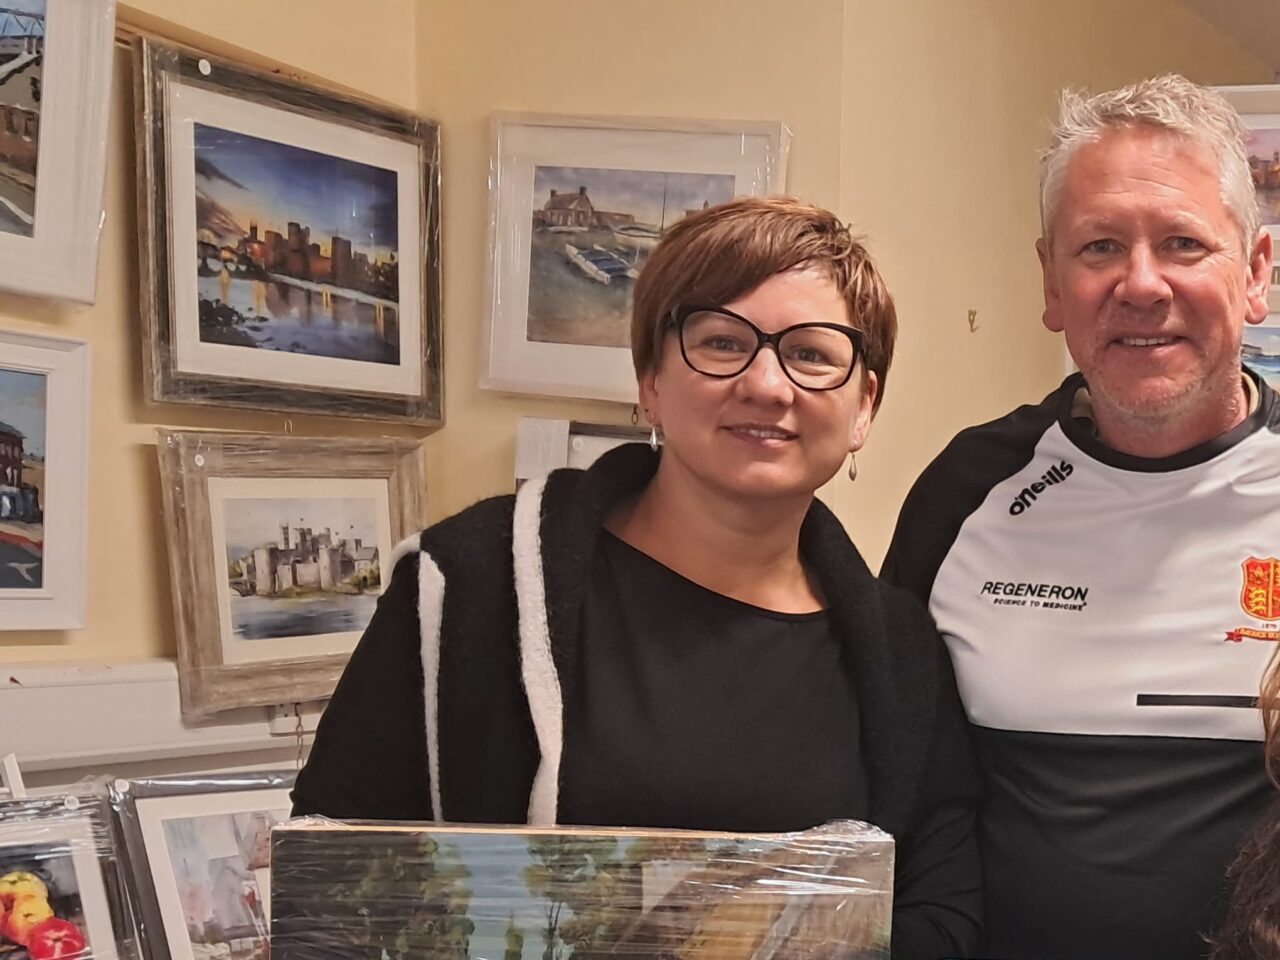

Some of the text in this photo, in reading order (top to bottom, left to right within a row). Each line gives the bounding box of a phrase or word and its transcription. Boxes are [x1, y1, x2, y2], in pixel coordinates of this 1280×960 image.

[981, 581, 1088, 601] REGENERON
[993, 598, 1027, 607] SCIENCE
[1030, 600, 1041, 608] TO
